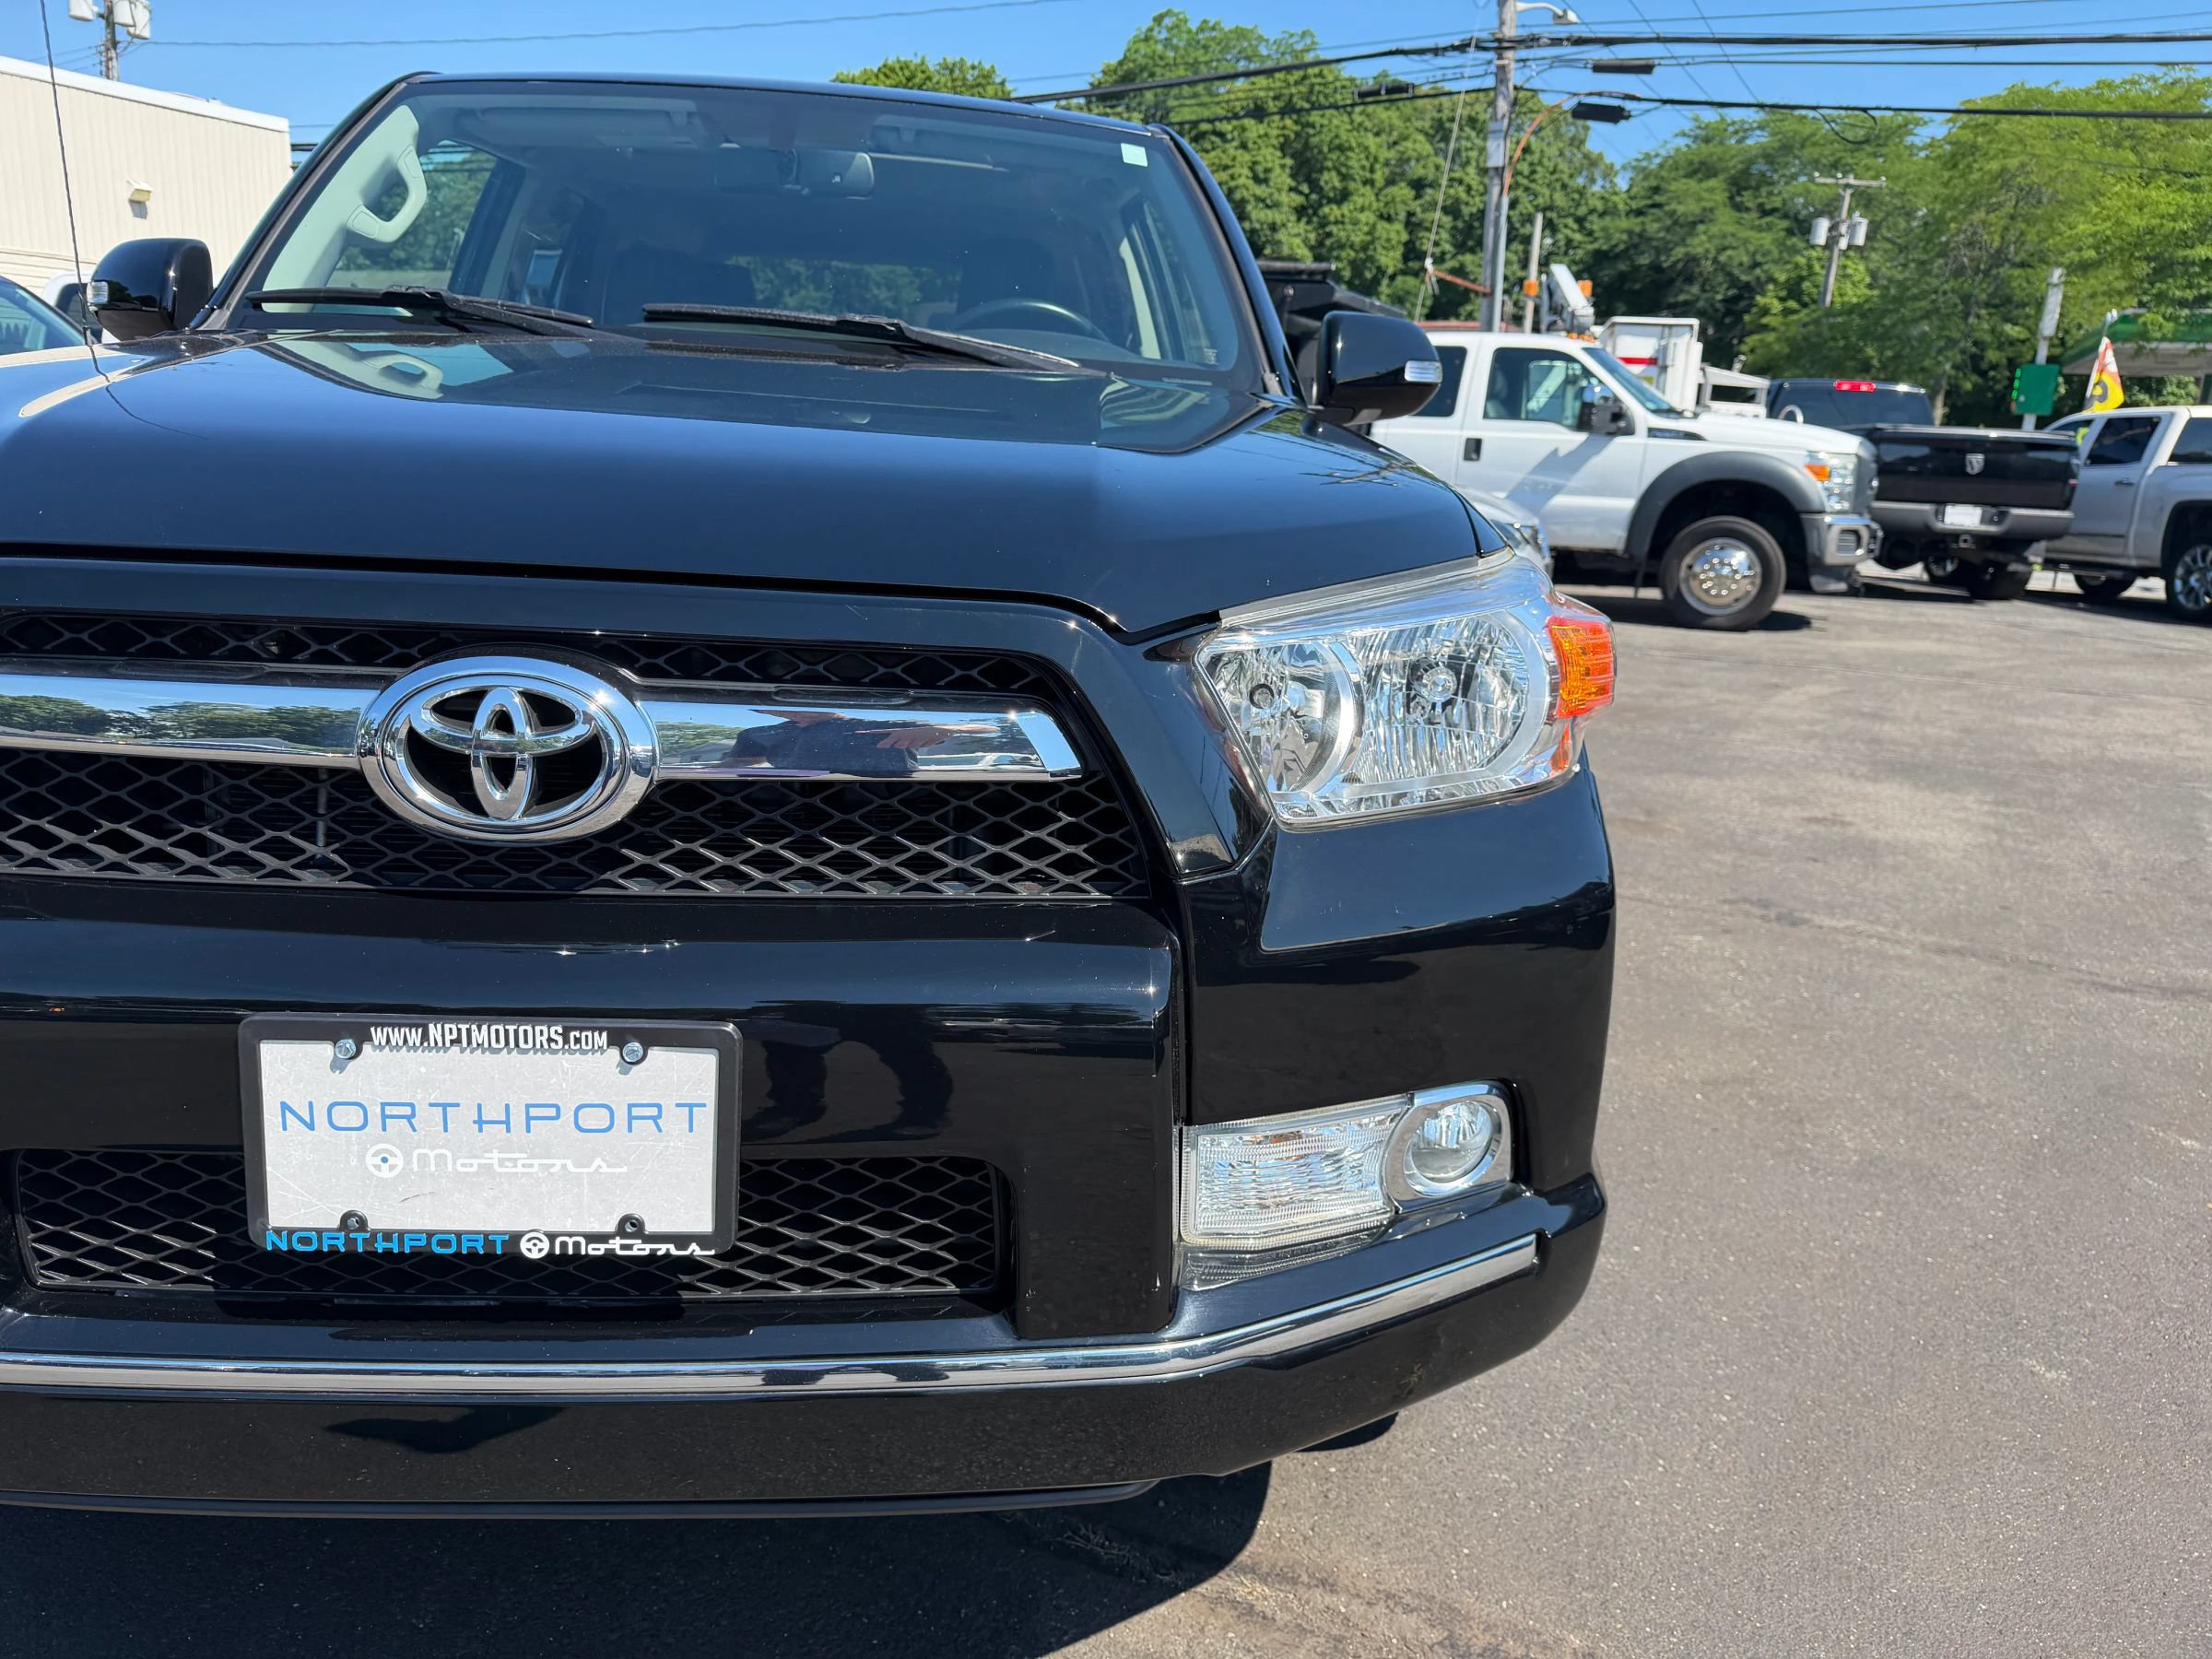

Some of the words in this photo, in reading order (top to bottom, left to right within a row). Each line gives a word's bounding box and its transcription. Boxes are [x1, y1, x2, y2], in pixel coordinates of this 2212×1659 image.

[370, 1023, 608, 1051] WWW.NPTMOTORS.COM
[279, 1100, 707, 1134] NORTHPORT
[413, 1148, 629, 1173] Motors
[266, 1230, 510, 1254] NORTHPORT
[555, 1236, 715, 1257] Motors
